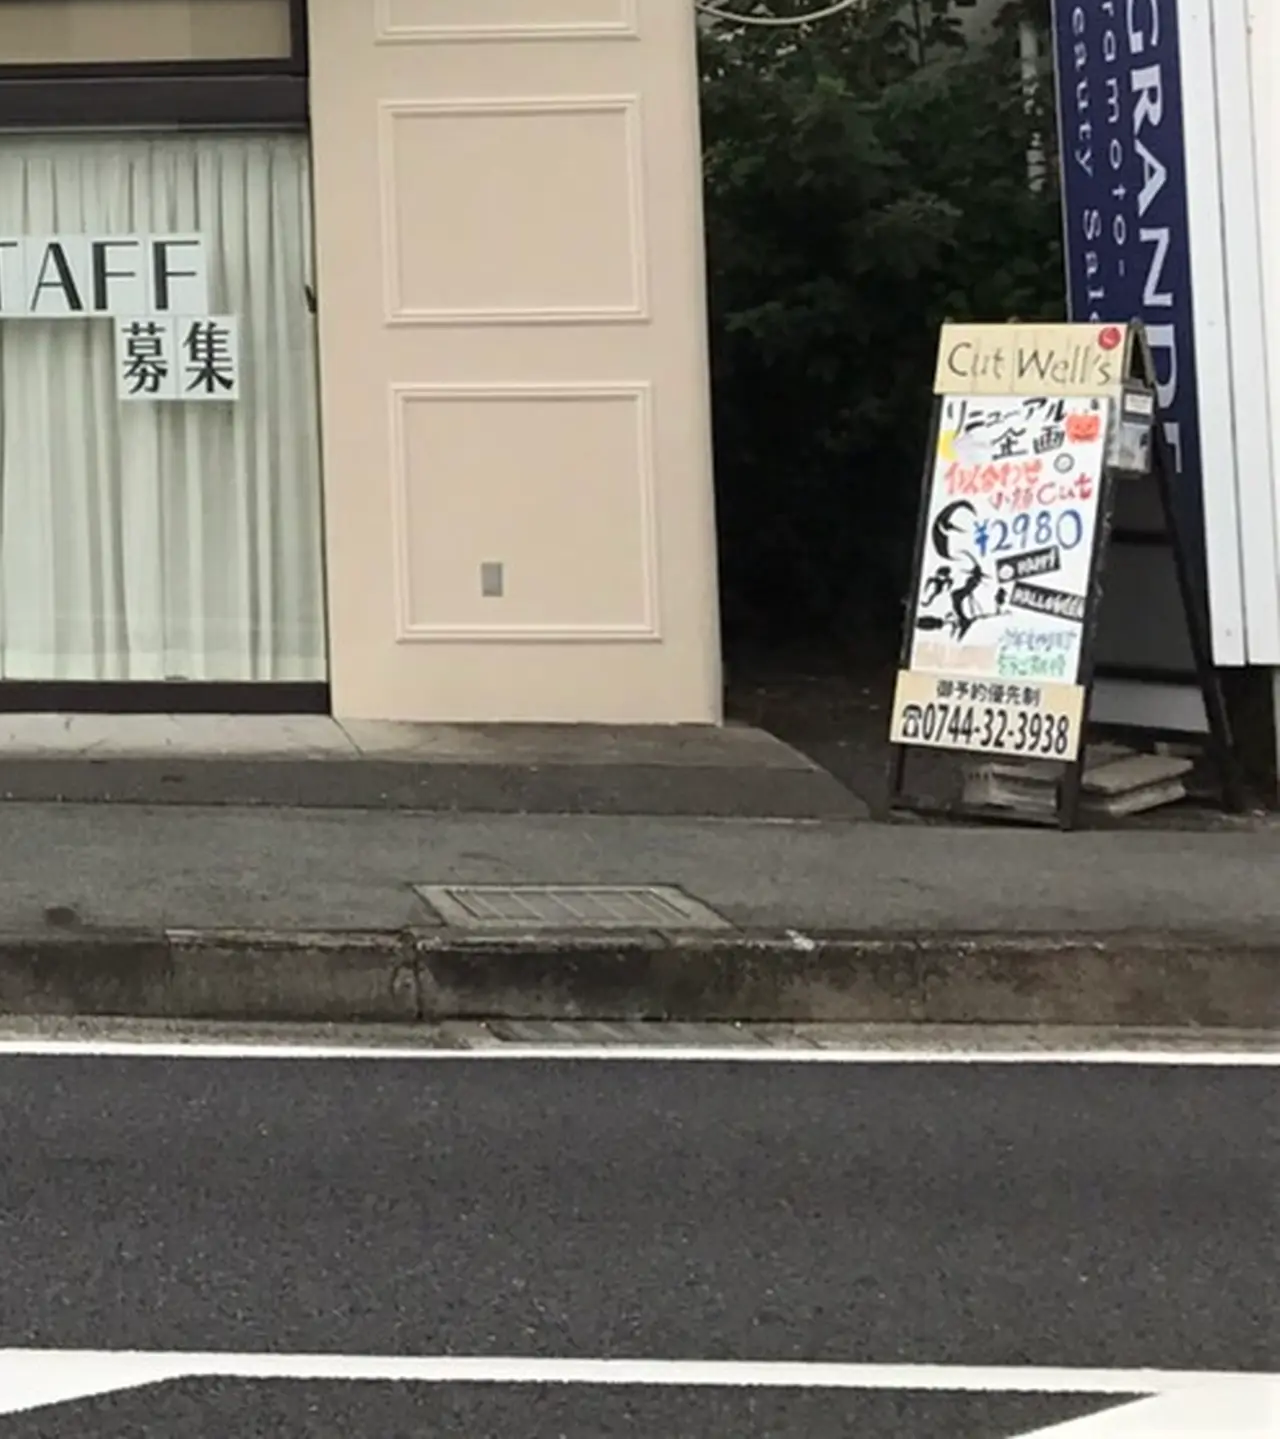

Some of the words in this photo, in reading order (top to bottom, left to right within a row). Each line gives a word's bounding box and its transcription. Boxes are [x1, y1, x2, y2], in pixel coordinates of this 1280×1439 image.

[121, 321, 235, 394] 募集
[947, 342, 1004, 379] Cut
[1017, 345, 1113, 386] Well's
[945, 397, 1067, 439] リニューアル
